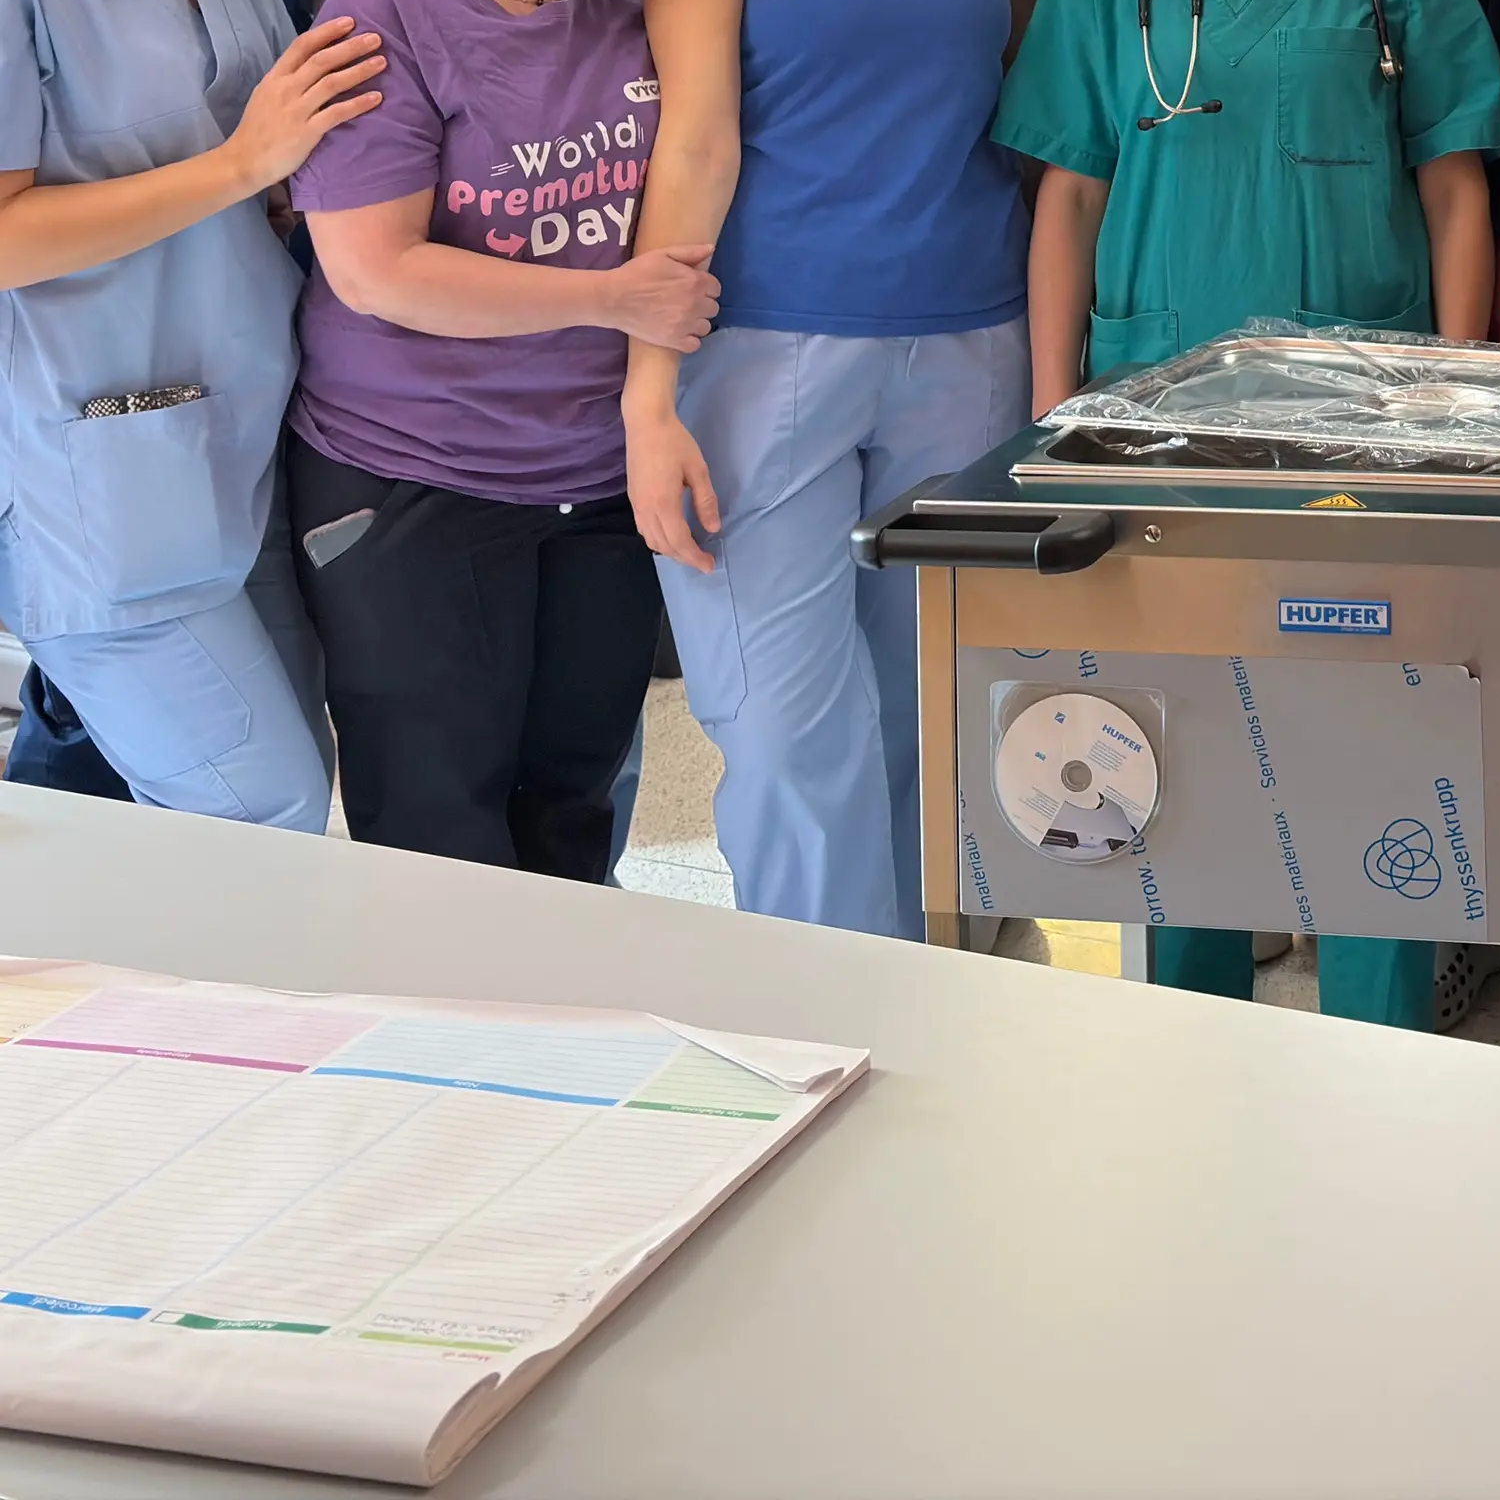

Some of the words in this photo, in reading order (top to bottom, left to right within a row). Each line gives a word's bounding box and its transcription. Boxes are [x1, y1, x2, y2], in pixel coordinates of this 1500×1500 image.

[630, 84, 660, 98] VYG
[511, 114, 637, 179] World
[1102, 723, 1142, 754] HUPFER
[1247, 715, 1277, 789] Servicios
[963, 832, 994, 911] matériaux
[1274, 811, 1304, 890] matériaux
[1434, 777, 1485, 921] thyssenkrupp
